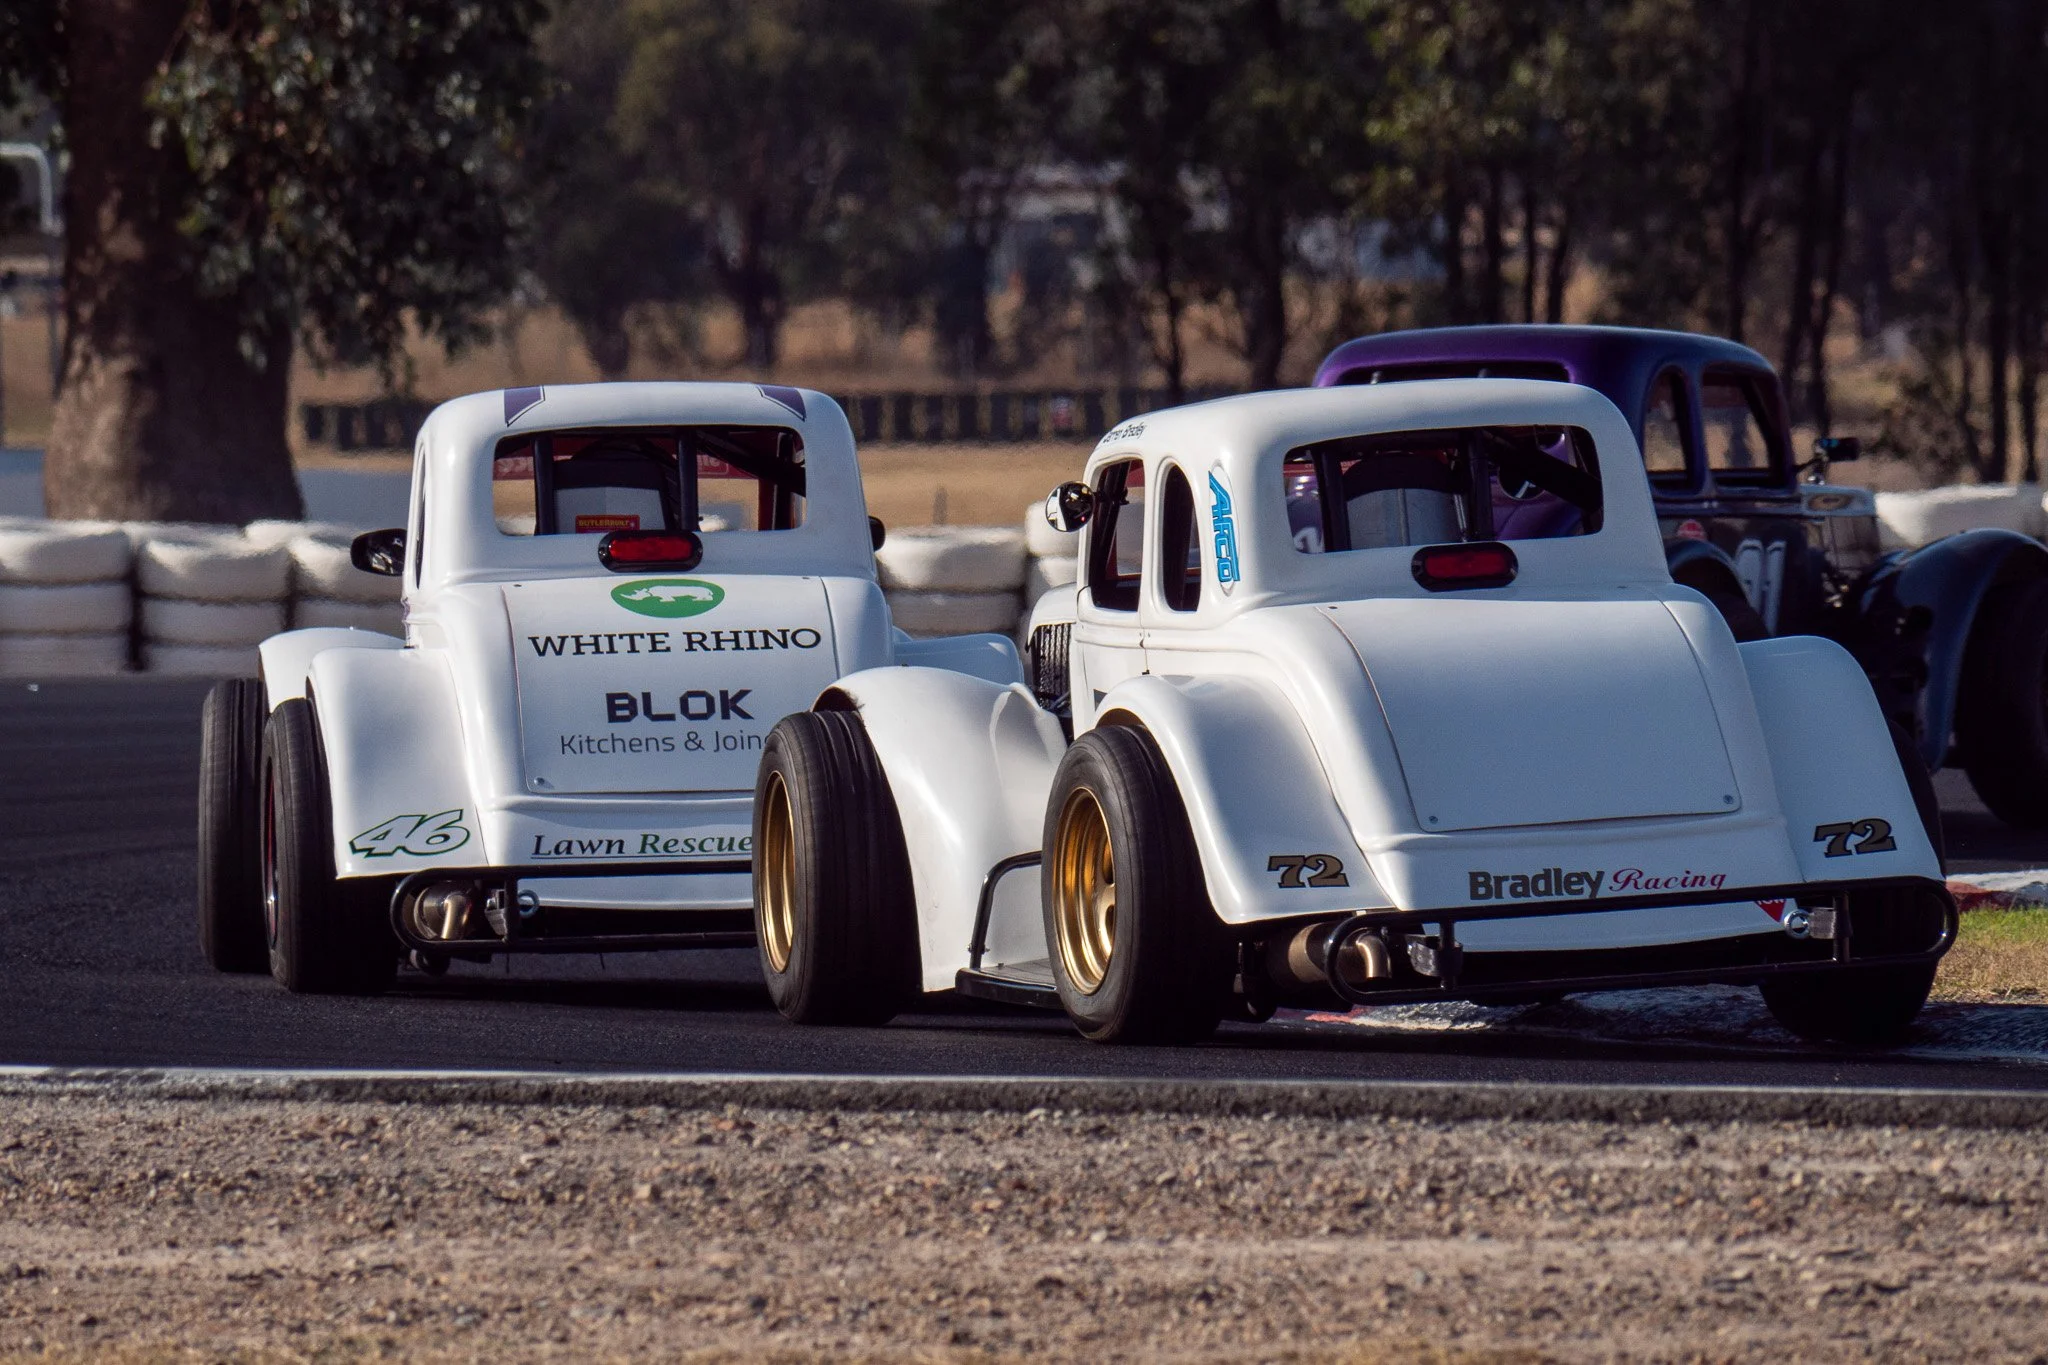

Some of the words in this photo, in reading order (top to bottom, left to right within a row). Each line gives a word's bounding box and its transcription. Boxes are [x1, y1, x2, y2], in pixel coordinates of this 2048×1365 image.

[528, 632, 672, 657] WHITE
[683, 628, 822, 653] RHINO
[605, 689, 755, 723] BLOK
[560, 732, 676, 755] Kitchens
[684, 731, 706, 752] &
[714, 730, 769, 753] Join
[349, 809, 471, 858] 46
[531, 834, 625, 857] Lawn
[638, 832, 753, 855] Rescue
[1813, 818, 1897, 858] 72
[1267, 854, 1350, 888] 72
[1468, 868, 1605, 901] Bradley
[1609, 867, 1727, 892] Racing
